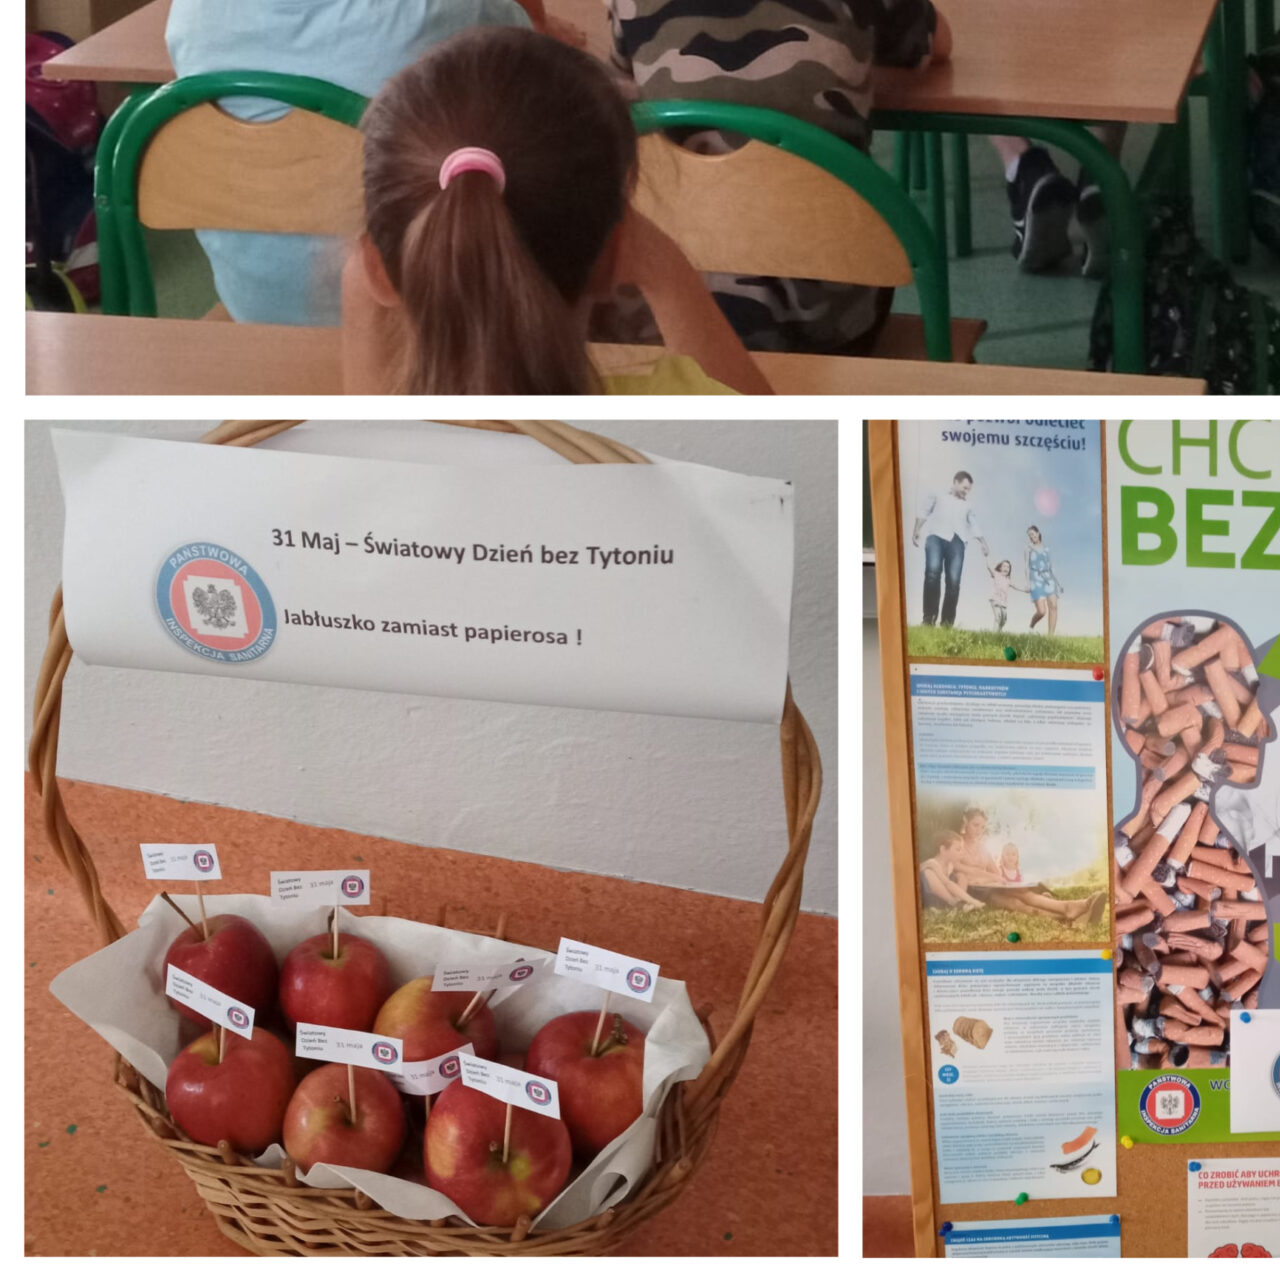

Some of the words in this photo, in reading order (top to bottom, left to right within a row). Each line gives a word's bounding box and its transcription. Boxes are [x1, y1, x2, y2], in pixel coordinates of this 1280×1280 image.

[942, 429, 1009, 446] swojemu
[1015, 435, 1086, 451] szczęściu!
[272, 529, 295, 547] 31
[302, 531, 340, 555] Maj
[364, 532, 465, 564] Światowy
[473, 544, 532, 563] Dzień
[541, 545, 578, 564] bez
[586, 545, 673, 569] Tytoniu
[166, 618, 225, 660] INSPEKCJA
[230, 627, 274, 660] SANITARNA
[382, 620, 458, 637] zamiast
[465, 625, 567, 644] papierosa
[577, 629, 581, 645] !
[1141, 1109, 1169, 1134] INSPEKCJA
[1171, 1107, 1199, 1134] SANITARNA
[1198, 1170, 1208, 1179] CO
[1210, 1169, 1239, 1179] ZROBIĆ
[1241, 1170, 1256, 1178] ABY
[1198, 1180, 1225, 1189] PRZED
[1227, 1178, 1275, 1188] UŻYWANIEM
